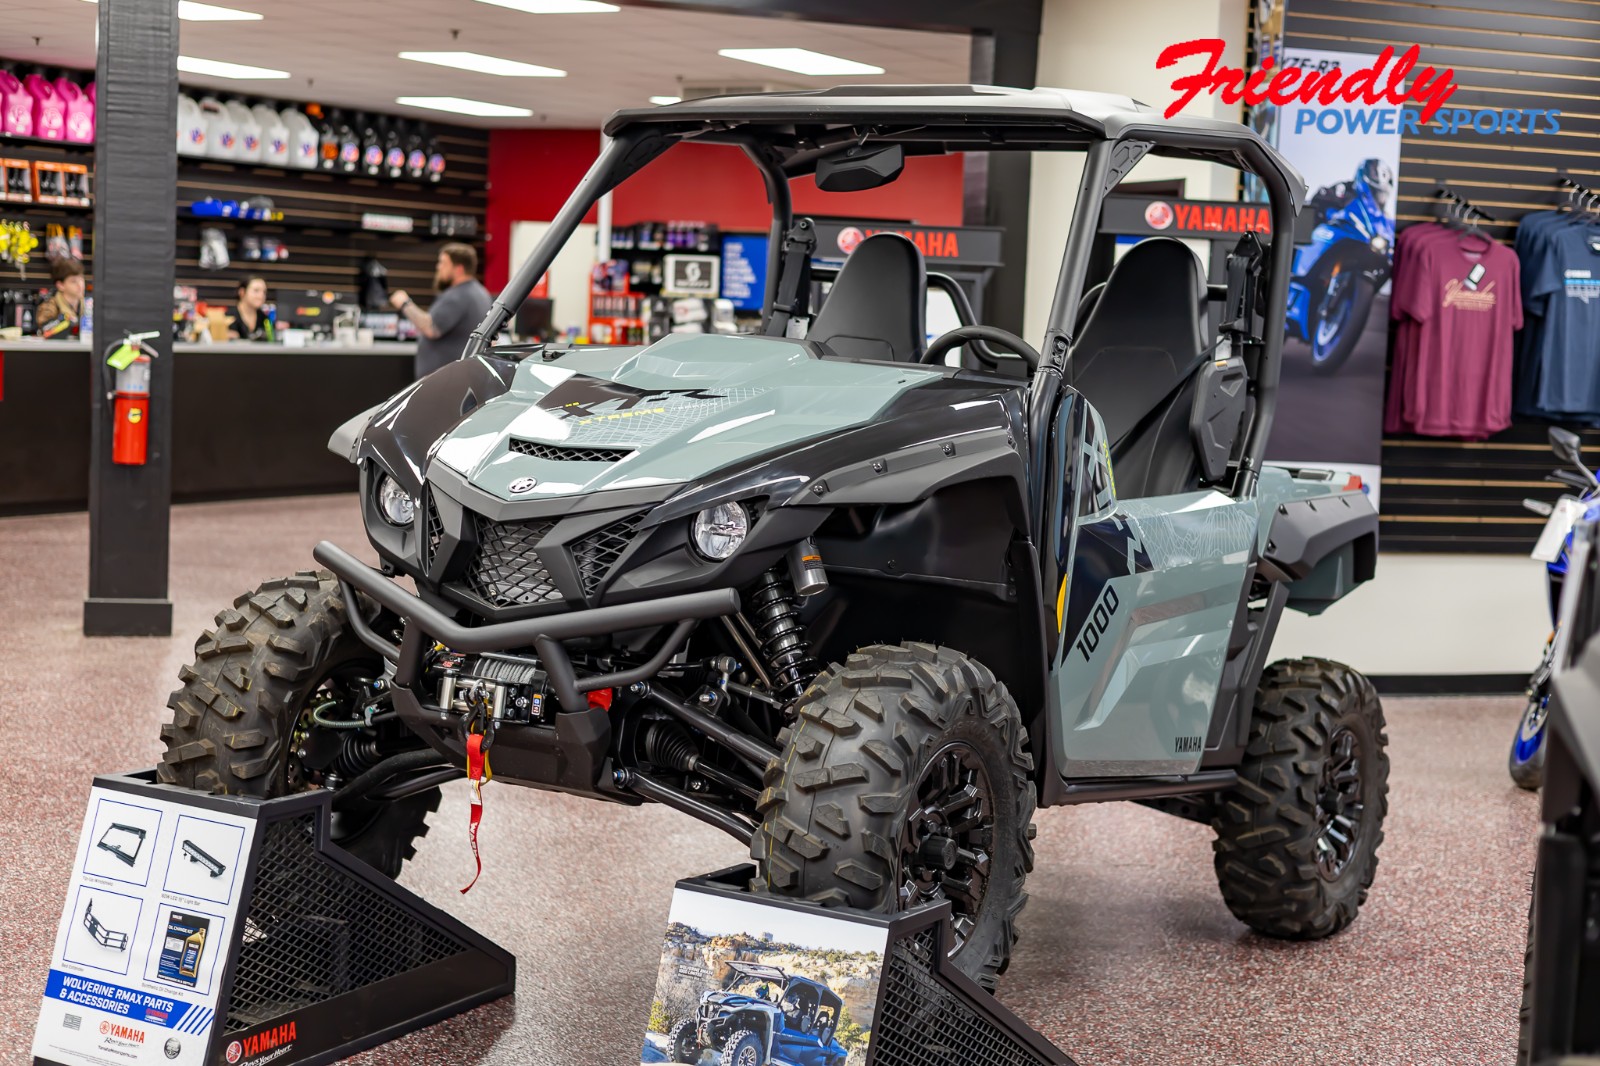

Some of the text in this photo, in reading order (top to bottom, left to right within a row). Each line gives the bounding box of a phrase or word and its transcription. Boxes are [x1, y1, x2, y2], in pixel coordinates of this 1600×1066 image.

[1174, 204, 1271, 234] YAMAHA
[578, 407, 666, 426] XTREME
[1076, 584, 1120, 663] 1000
[1174, 736, 1202, 752] YAMAHA
[59, 989, 130, 1015] & ACCESSORIES
[62, 975, 174, 1013] WOLVERINE RMAX PARTS
[110, 1023, 145, 1044] YAMAHA
[242, 1021, 297, 1058] YAMAHA
